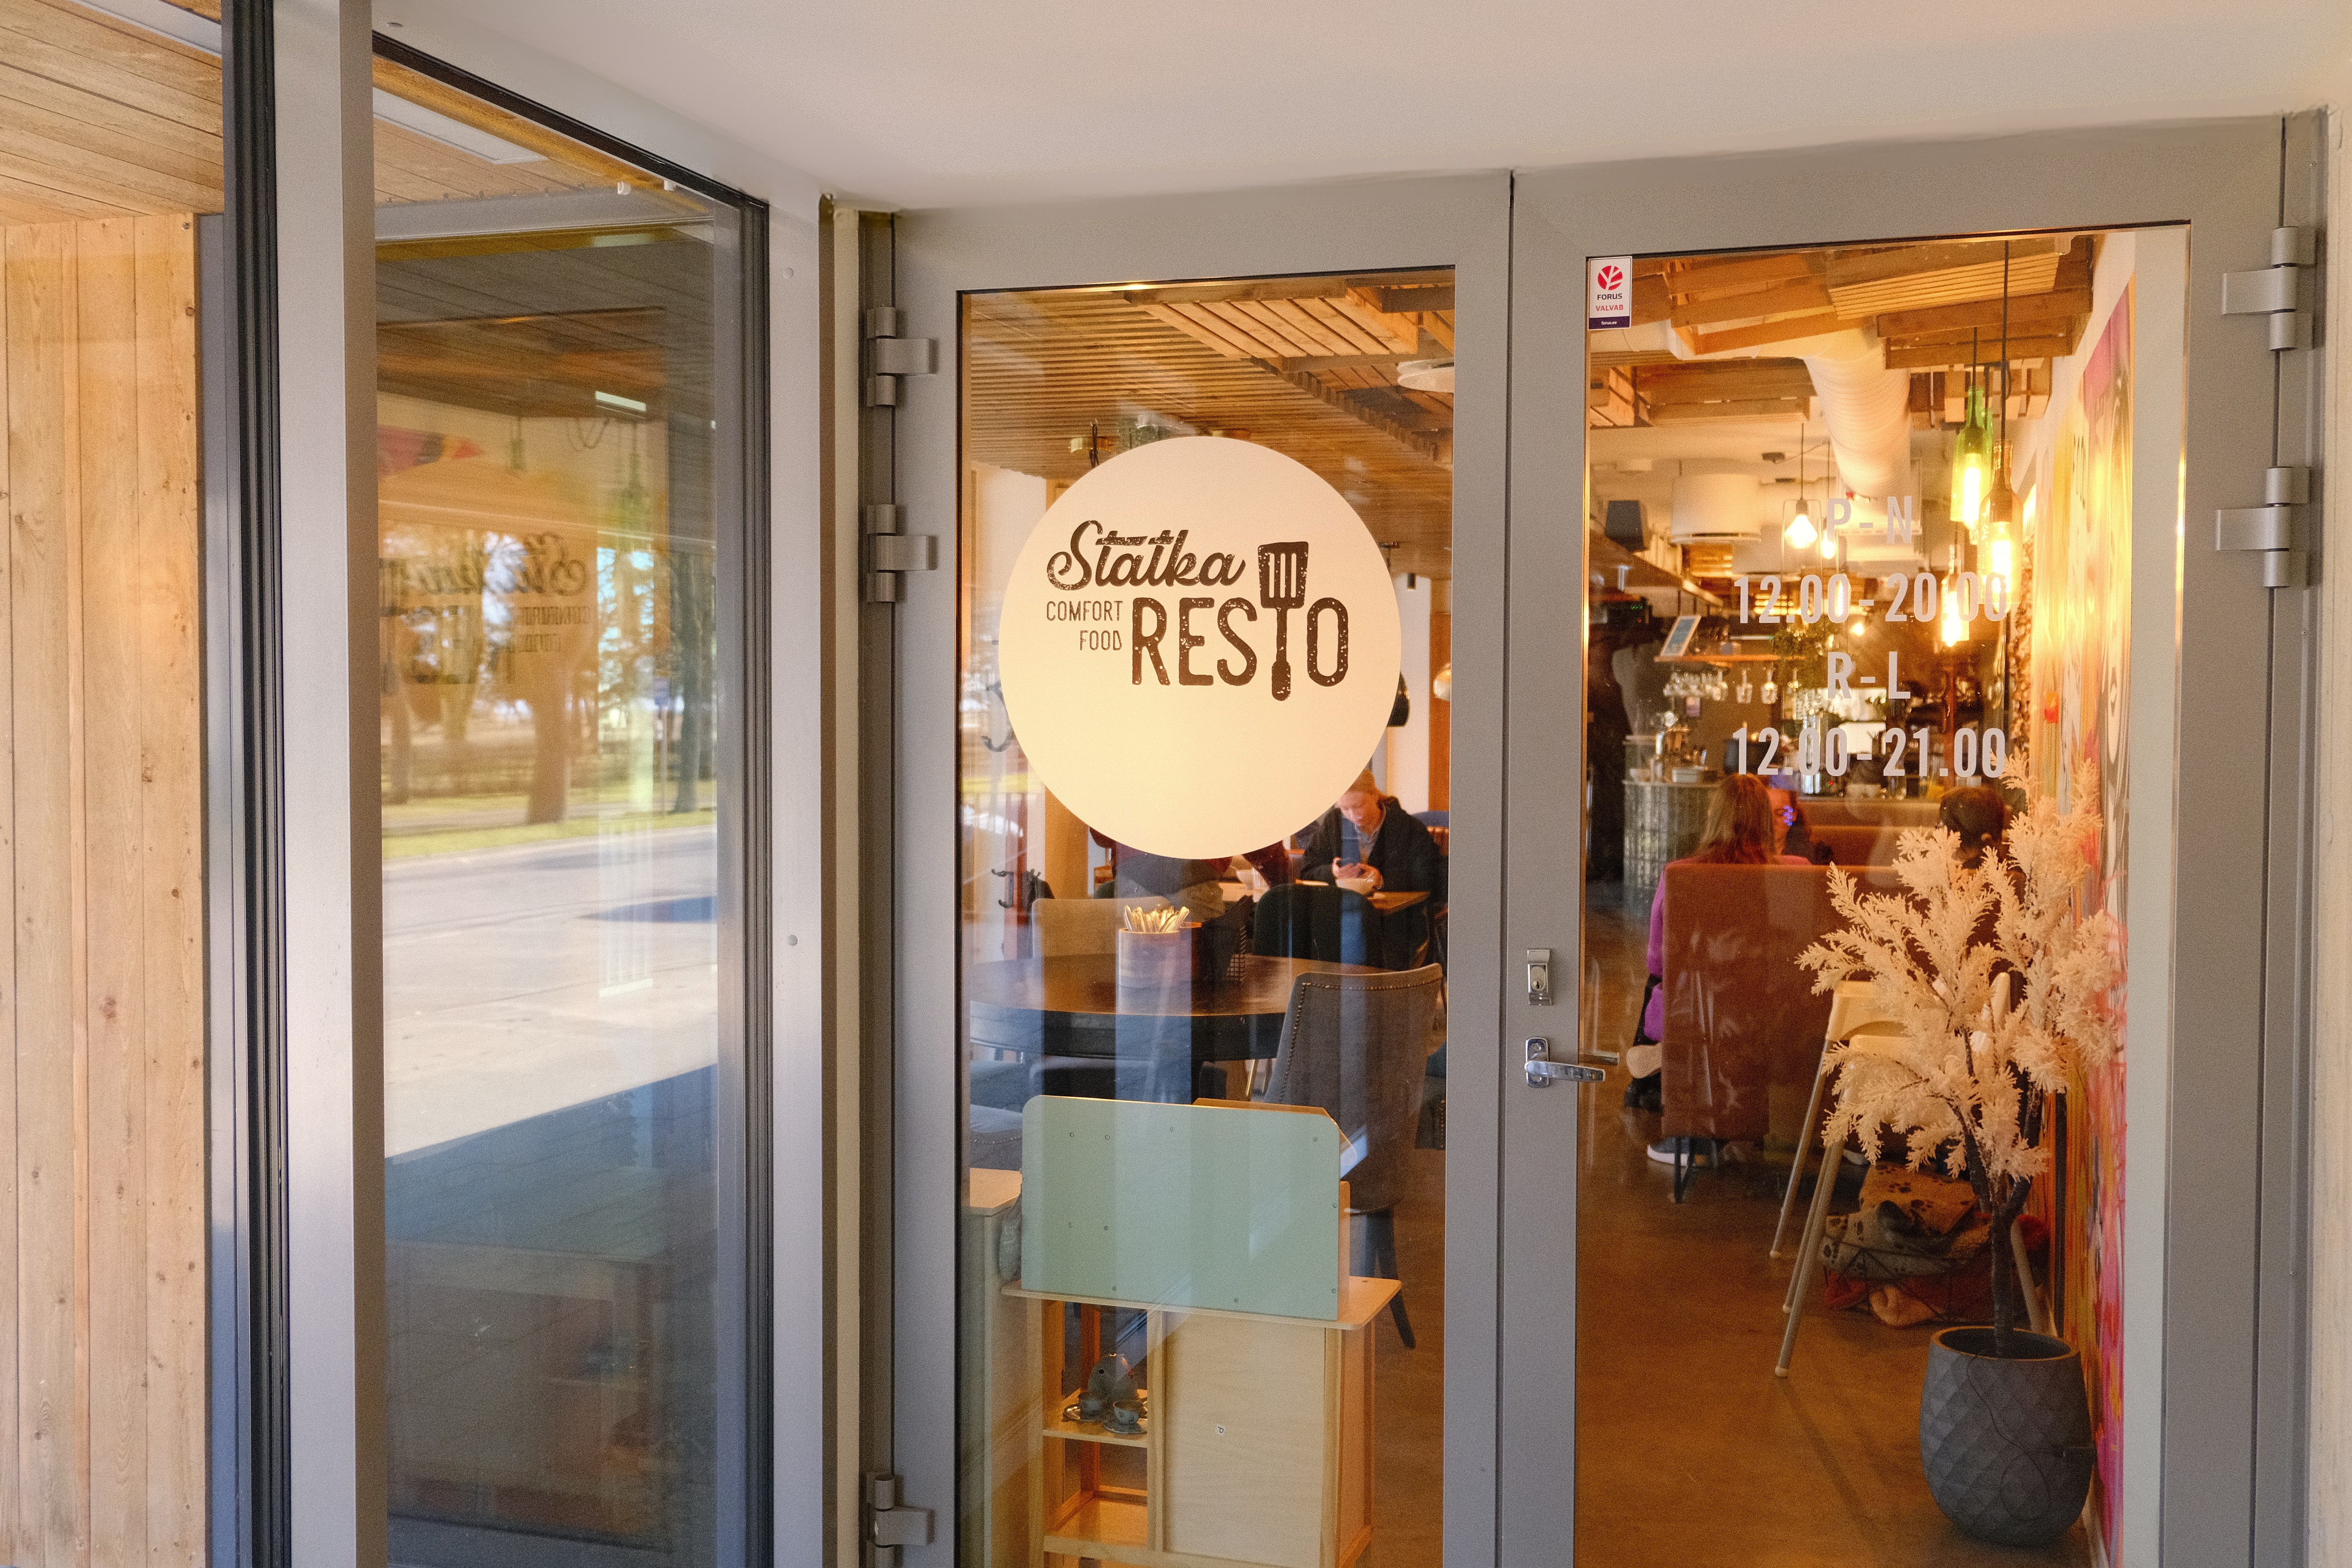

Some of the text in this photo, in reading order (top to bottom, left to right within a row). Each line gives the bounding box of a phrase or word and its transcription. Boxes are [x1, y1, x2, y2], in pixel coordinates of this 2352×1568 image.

[1047, 520, 1246, 591] Statka
[1046, 601, 1123, 622] COMFORT
[1132, 542, 1349, 701] RESTO
[1079, 630, 1122, 651] FOOD
[1732, 727, 2006, 778] 12.00-21.00
